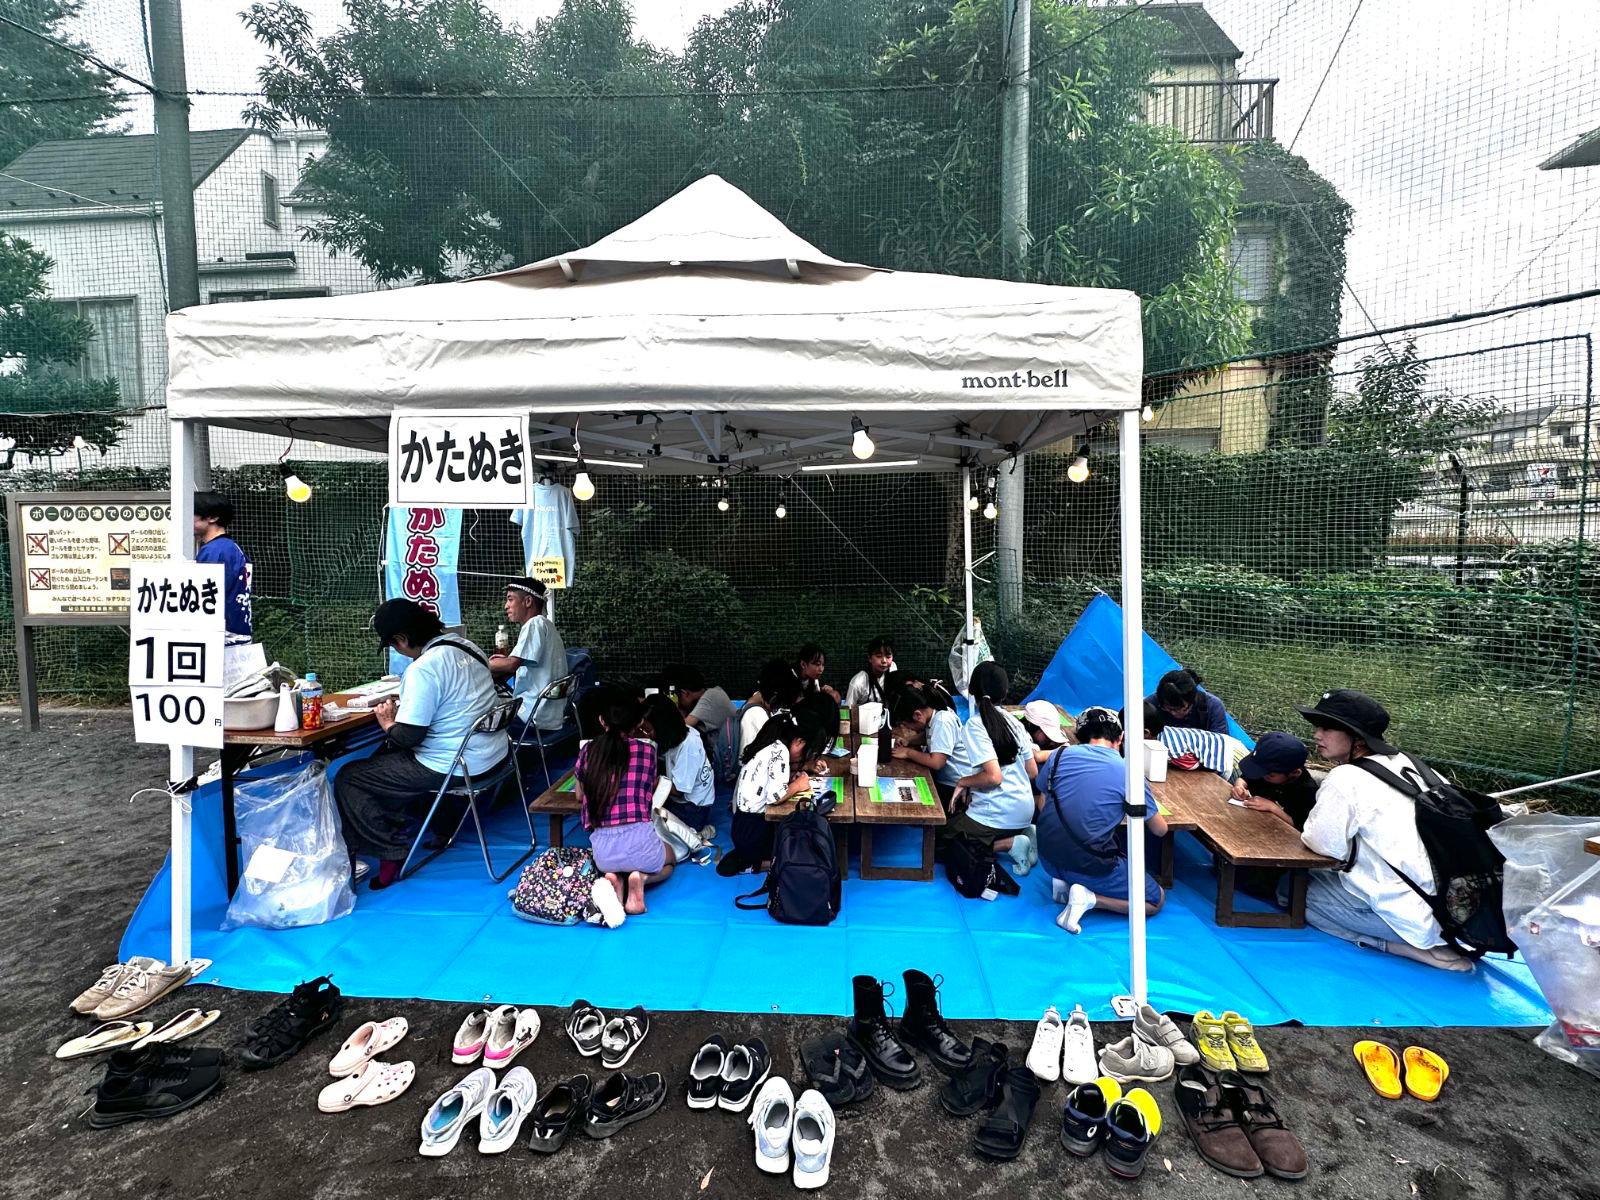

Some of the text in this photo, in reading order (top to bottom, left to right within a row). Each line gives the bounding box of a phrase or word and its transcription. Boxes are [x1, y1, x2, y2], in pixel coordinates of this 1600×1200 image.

[400, 429, 524, 484] かたぬき
[403, 508, 445, 618] かたぬ
[137, 578, 218, 615] かたぬき
[136, 637, 206, 683] 1回
